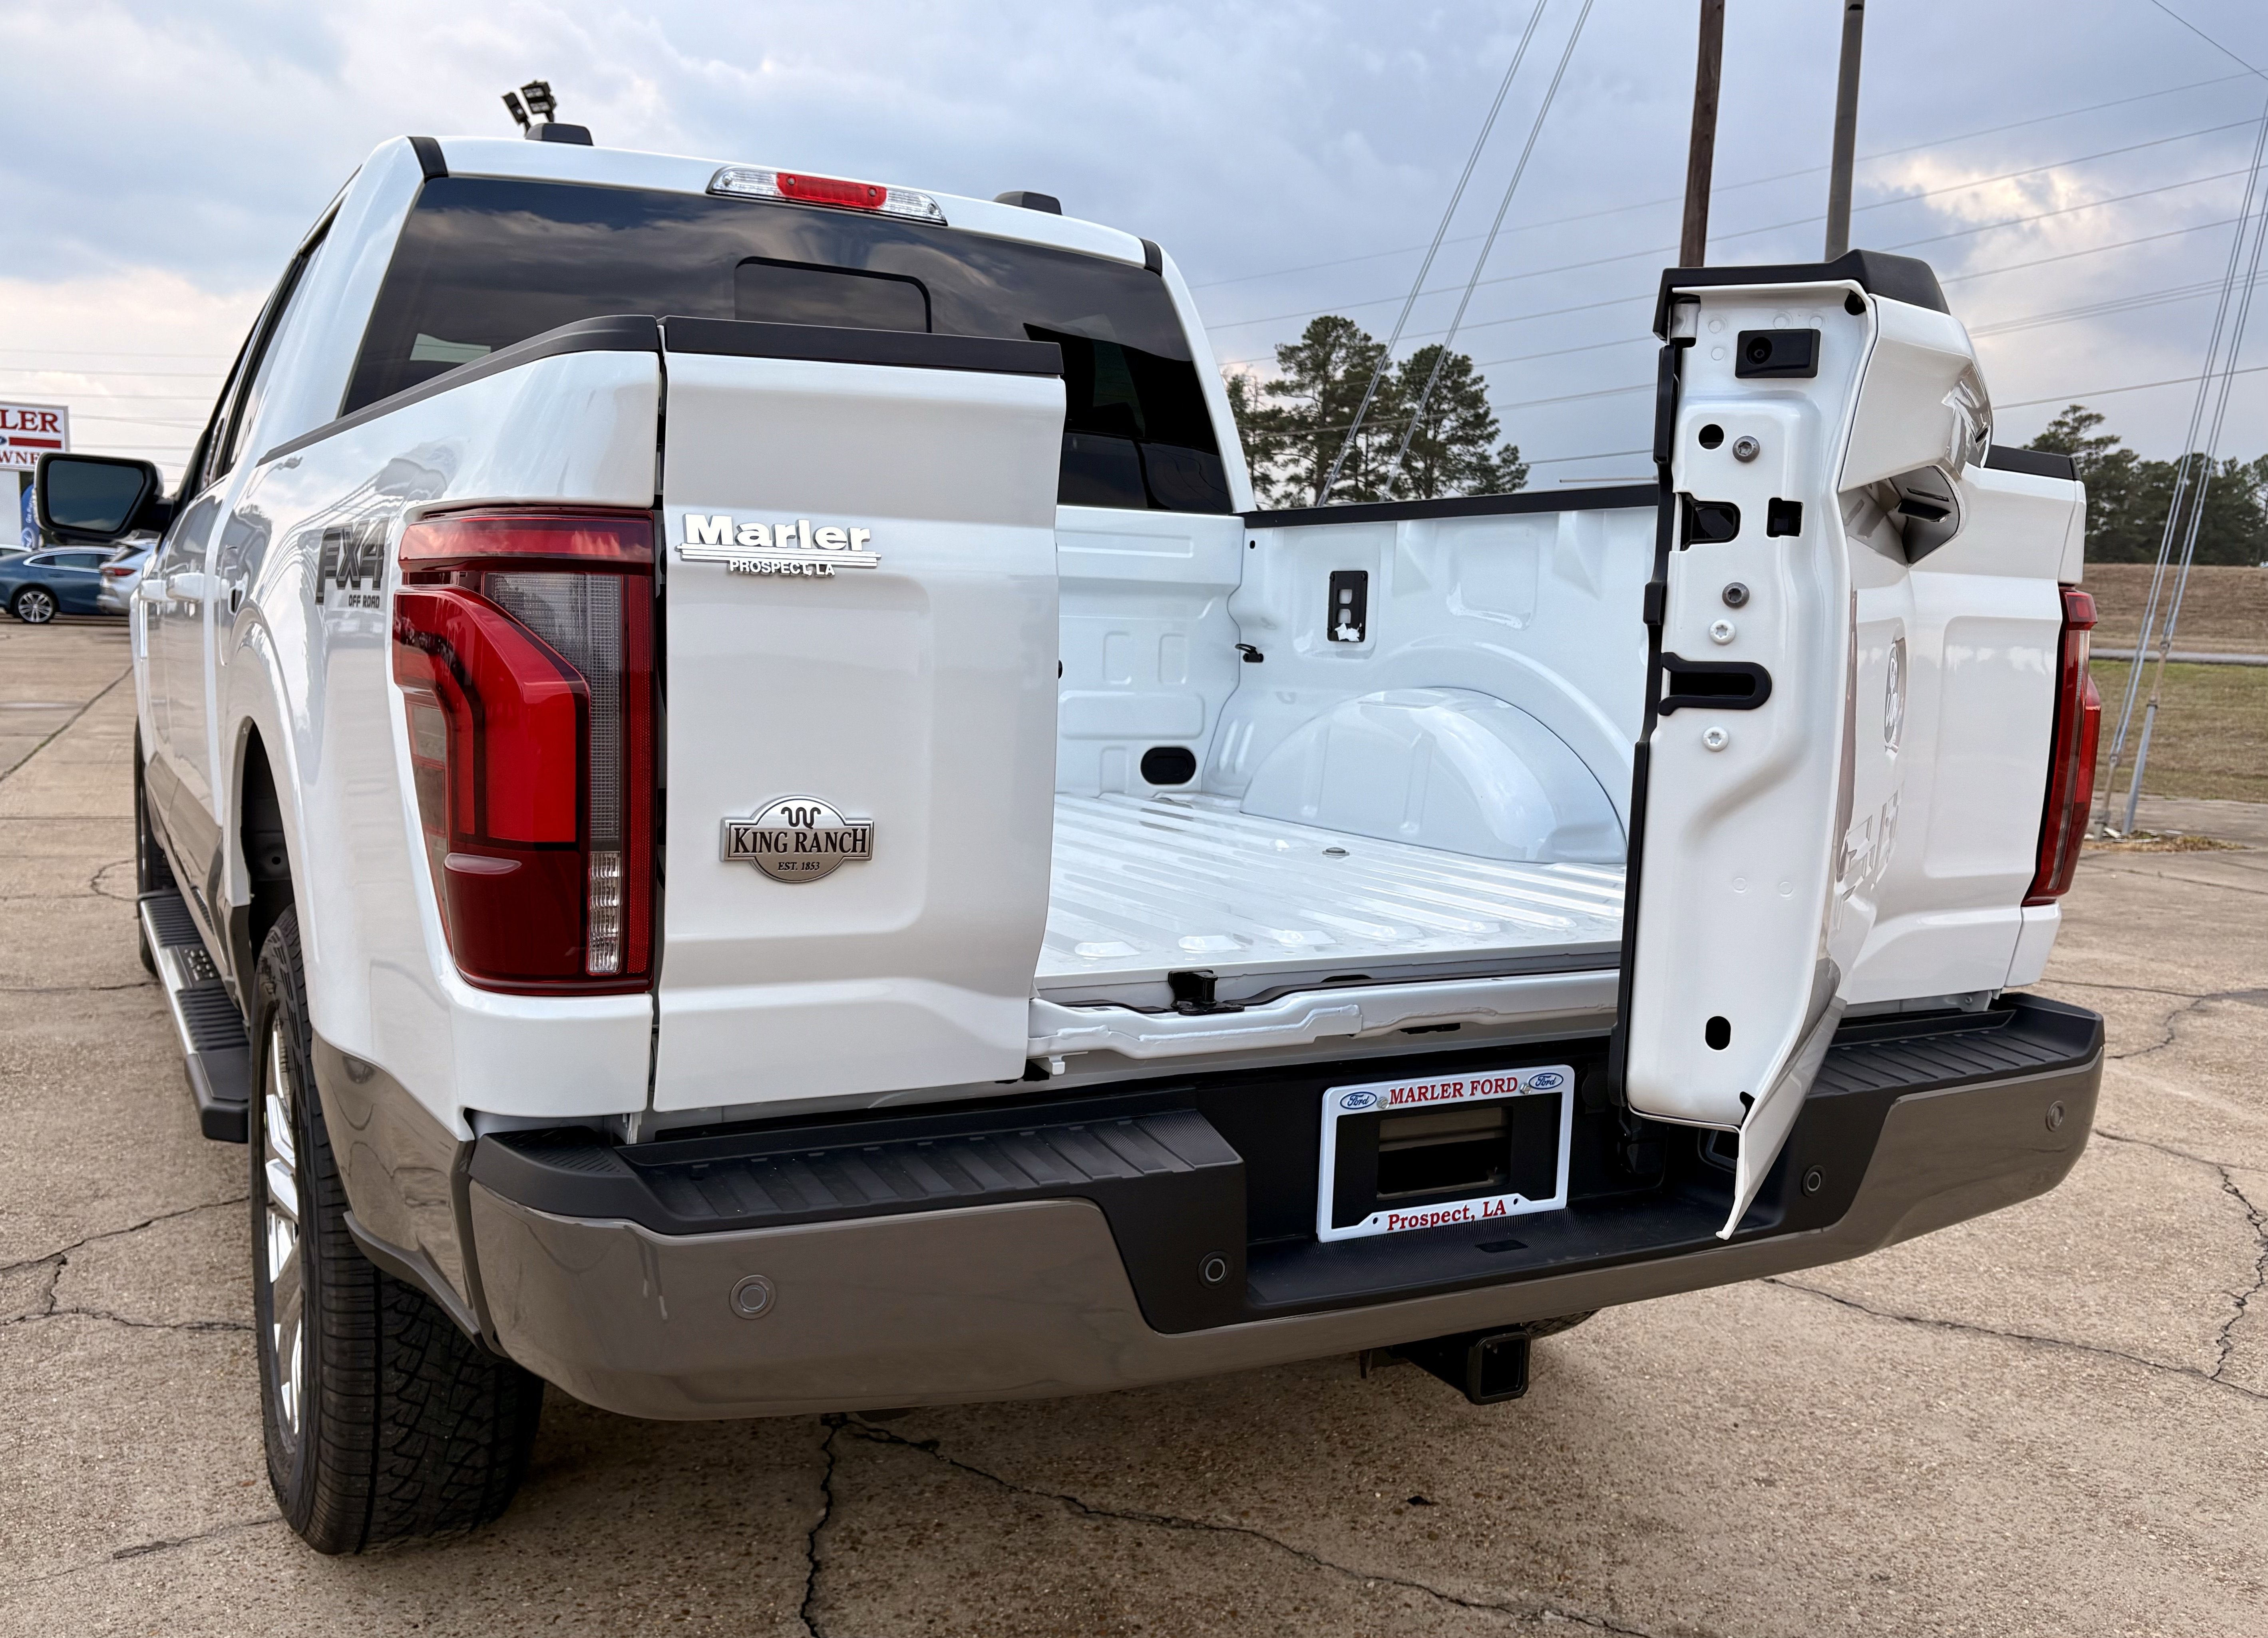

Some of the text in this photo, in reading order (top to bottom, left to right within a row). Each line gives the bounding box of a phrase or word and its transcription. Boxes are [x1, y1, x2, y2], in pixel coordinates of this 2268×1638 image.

[683, 514, 870, 551] Marler
[315, 517, 390, 605] FX4
[816, 563, 835, 575] LA
[349, 594, 380, 609] OFF ROAD
[733, 828, 867, 853] KING RANCH
[778, 861, 820, 871] EST. 1853
[1389, 1077, 1518, 1105] MARLER FORD
[1387, 1199, 1506, 1231] Prospect, LA
